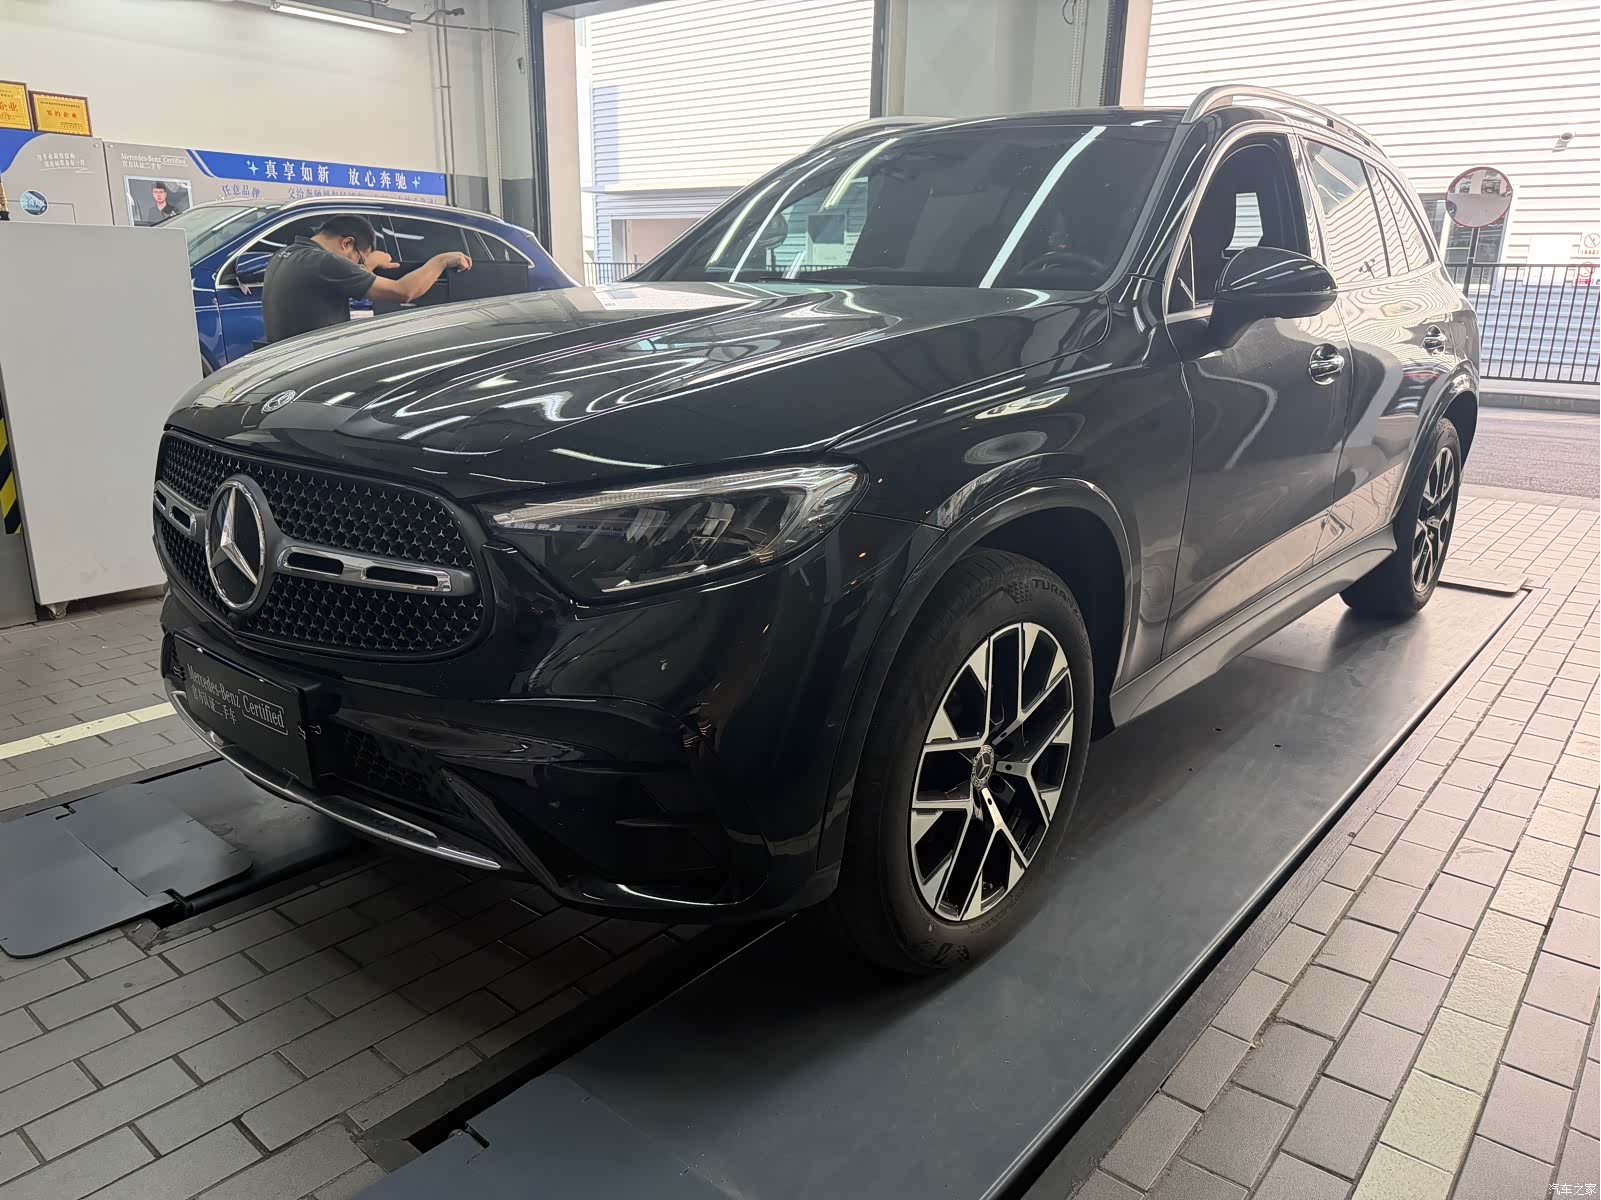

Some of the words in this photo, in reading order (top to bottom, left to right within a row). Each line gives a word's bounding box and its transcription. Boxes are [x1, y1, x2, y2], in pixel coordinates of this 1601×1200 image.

[121, 152, 161, 163] Mercedes-Benz
[162, 157, 186, 165] Certified
[264, 160, 330, 183] 真享如新
[348, 168, 408, 190] 放心奔驰
[221, 184, 261, 199] 任意品牌
[187, 663, 241, 709] Mercedes-Benz
[242, 694, 285, 729] Certified
